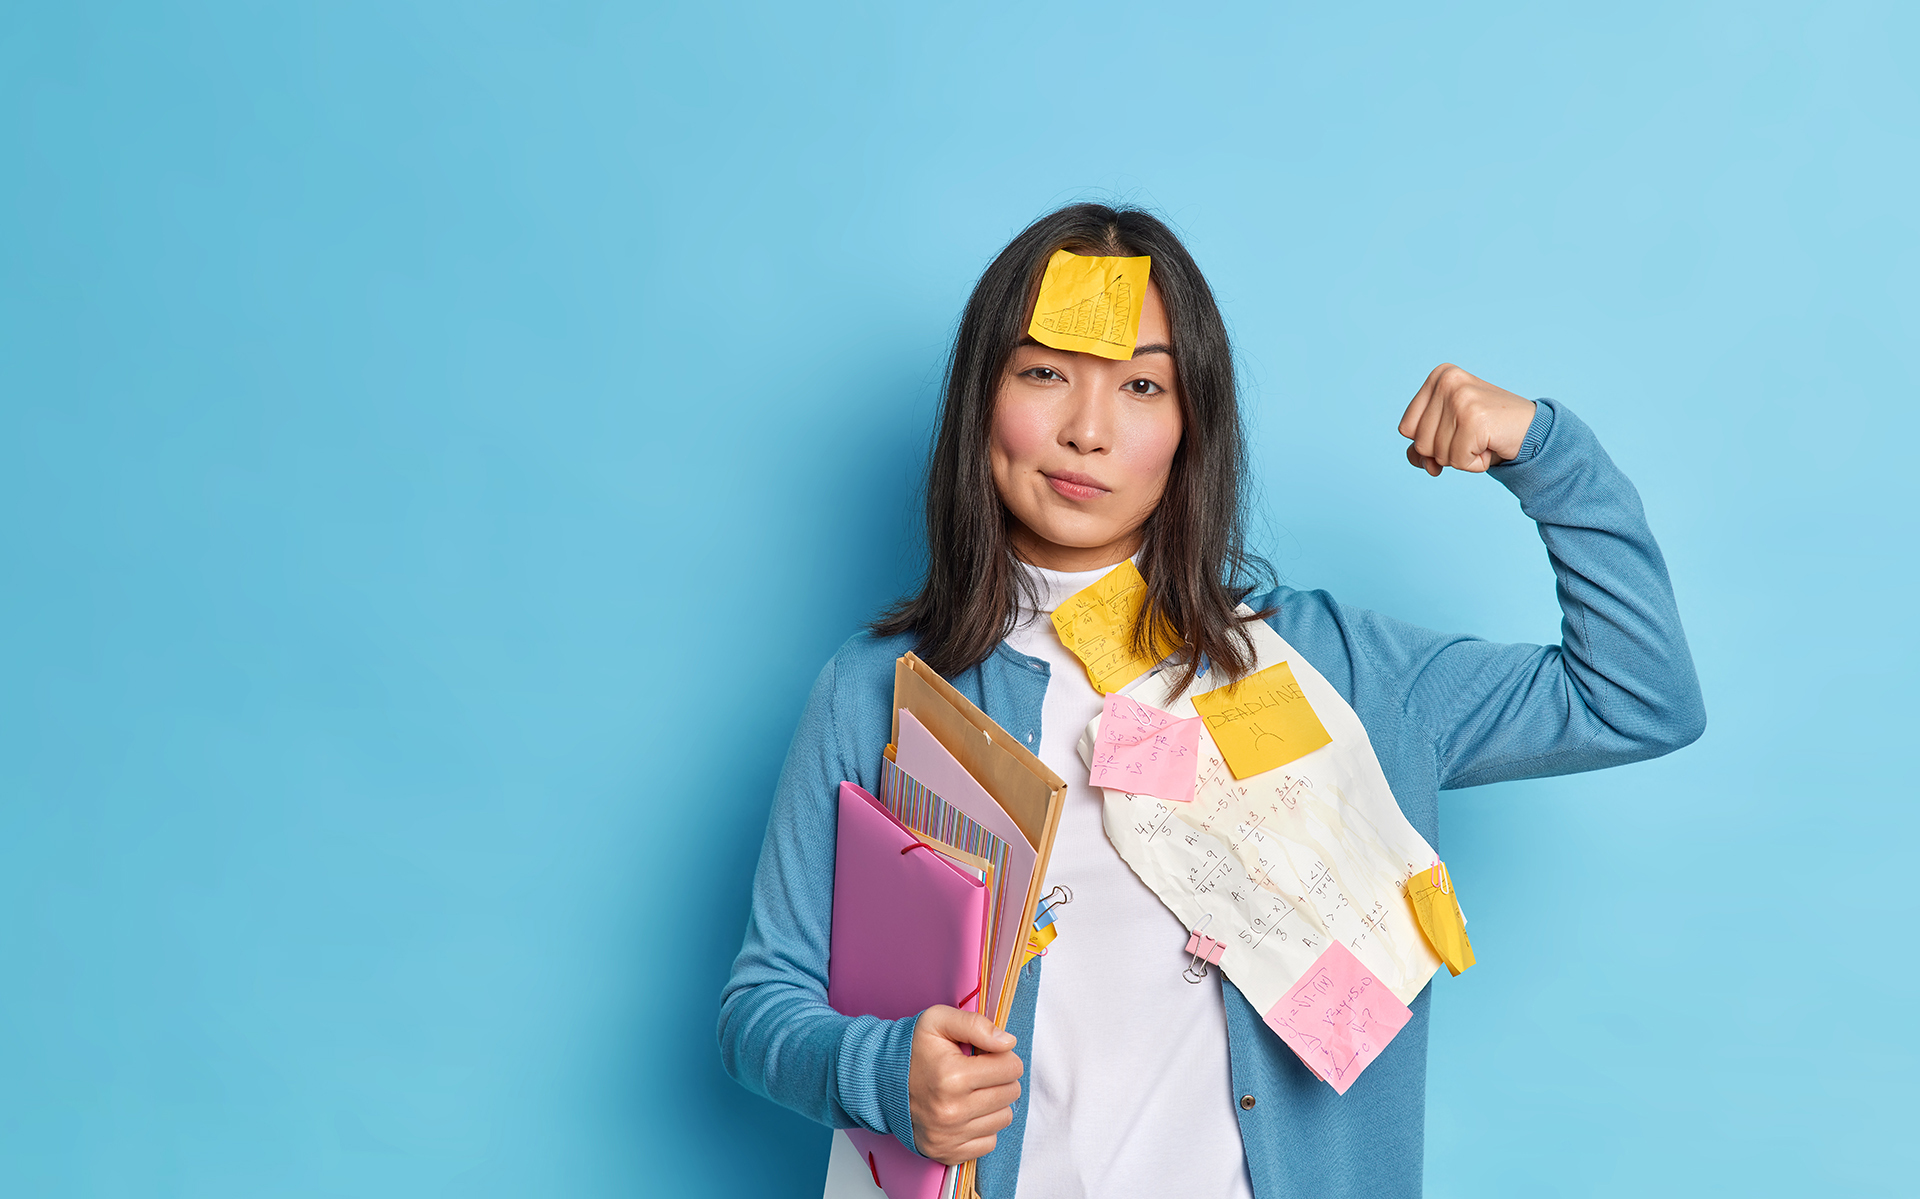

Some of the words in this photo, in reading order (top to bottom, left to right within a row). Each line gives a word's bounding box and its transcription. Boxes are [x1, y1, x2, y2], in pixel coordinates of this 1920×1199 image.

[1207, 683, 1305, 730] DEADLINE
[1254, 831, 1265, 843] 2
[1275, 927, 1289, 942] 3
